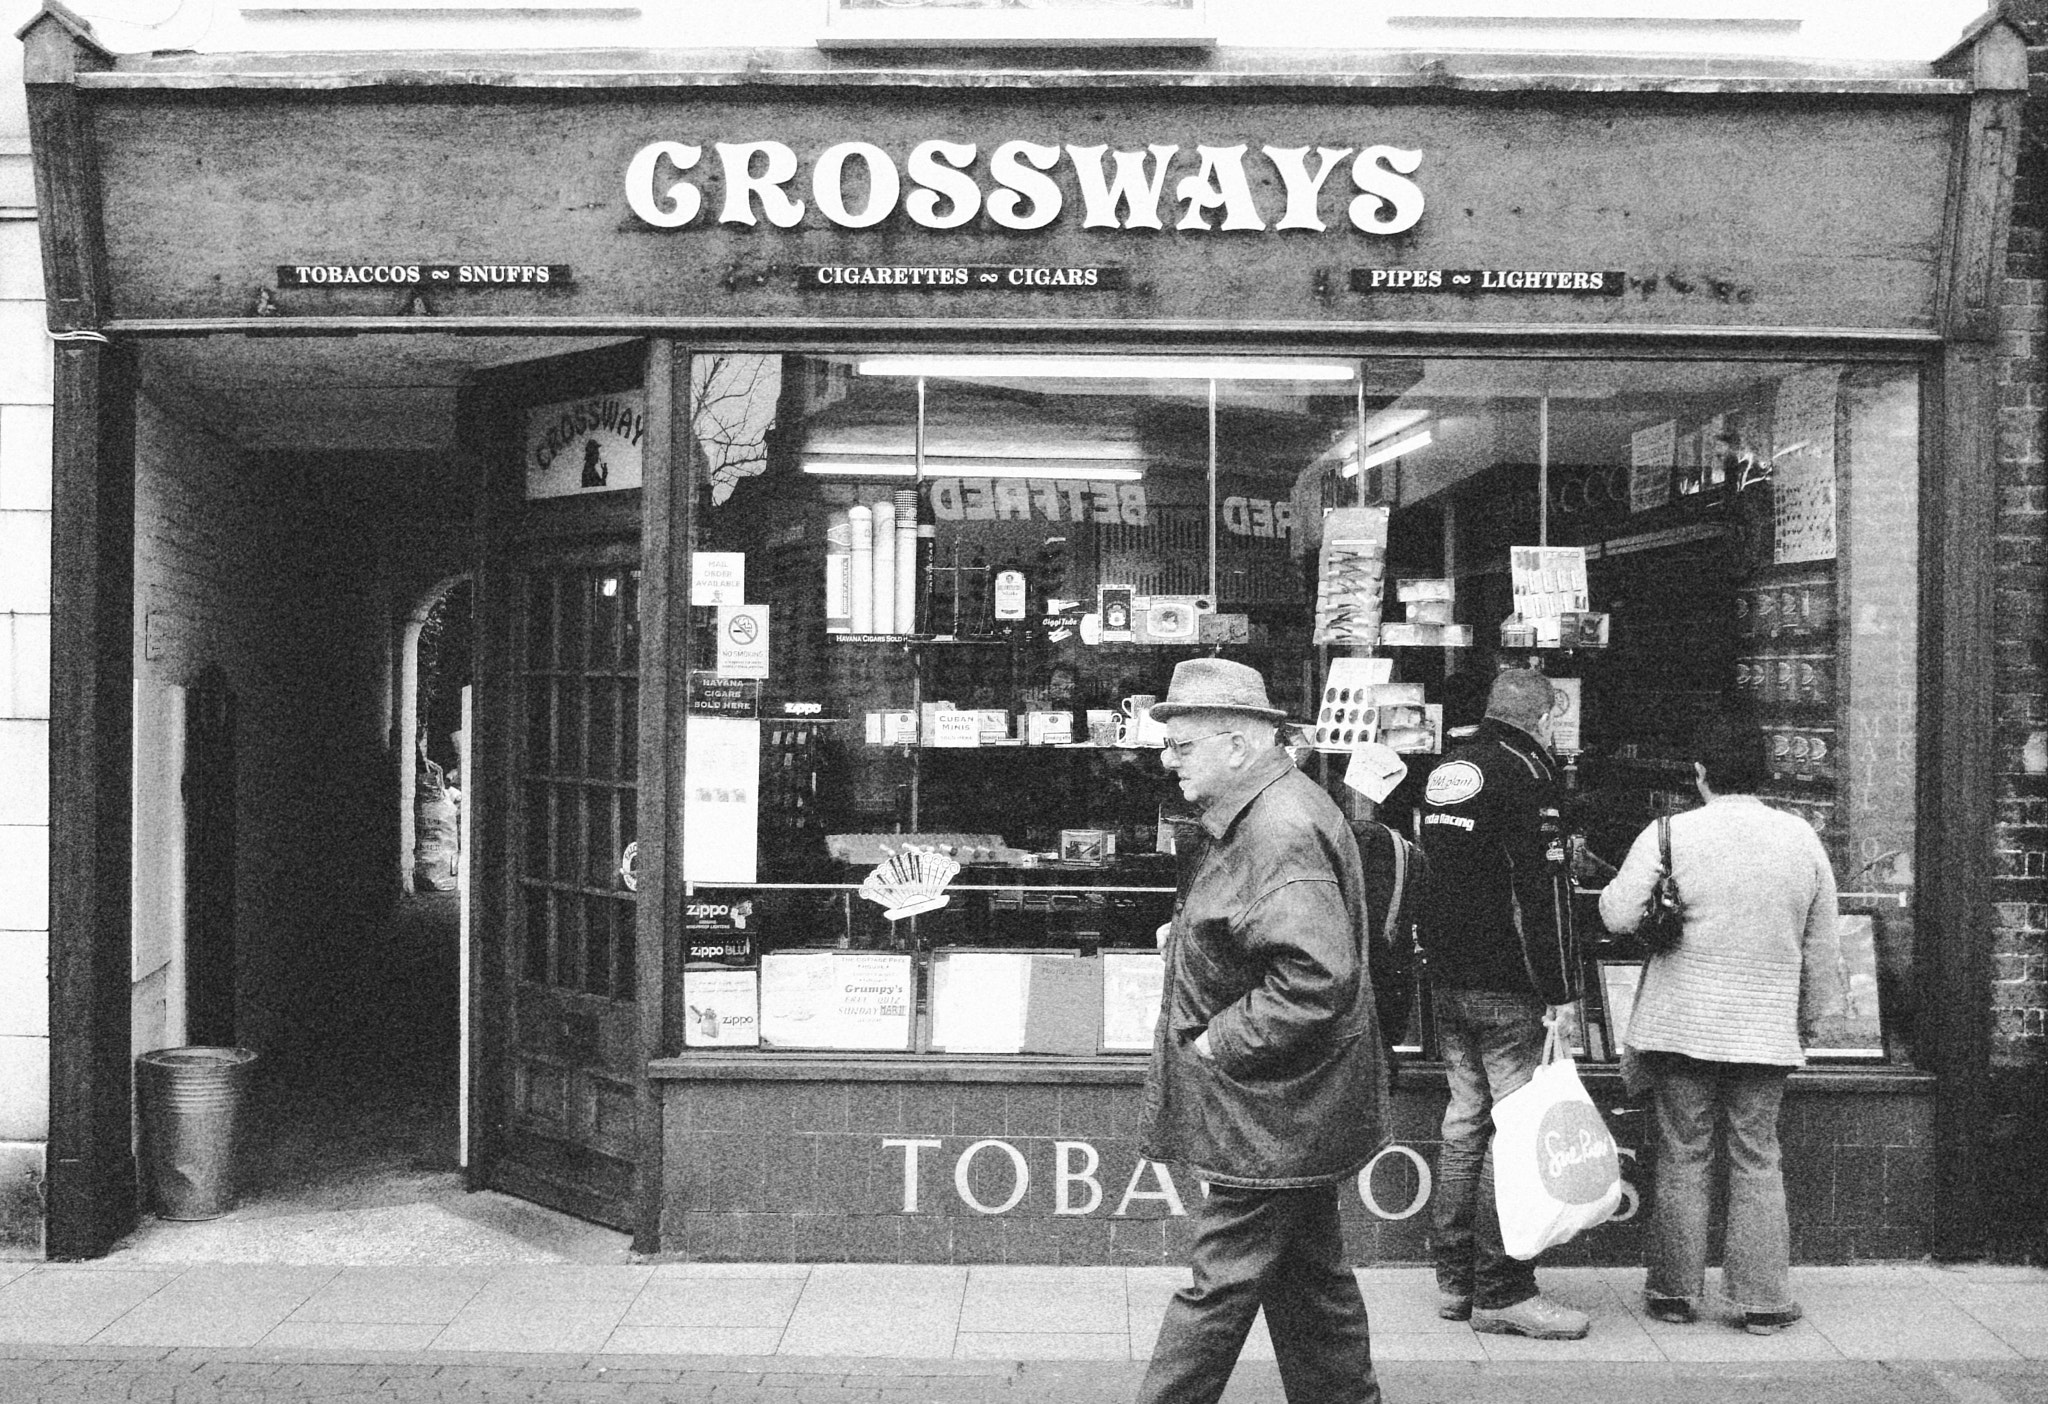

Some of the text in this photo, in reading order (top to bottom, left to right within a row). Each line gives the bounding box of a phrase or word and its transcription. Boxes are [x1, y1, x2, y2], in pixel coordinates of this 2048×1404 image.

[625, 139, 1425, 235] CROSSWAYS
[296, 266, 549, 283] TOBACCOS SNUFFS
[817, 267, 1098, 285] CIGARETTES CIGARS
[1371, 270, 1603, 289] PIPES LIGHTERS
[836, 634, 861, 643] HAVANA
[862, 635, 886, 643] CIGARS
[886, 635, 903, 643] SOLD
[702, 678, 744, 687] HAVANA
[704, 689, 742, 698] CIGARS
[694, 701, 751, 710] SOLD HERE
[940, 715, 974, 723] CUBAN
[686, 904, 729, 918] zippo
[690, 945, 724, 958] zippo
[844, 984, 903, 995] Grumpy's
[722, 1015, 753, 1027] zippo
